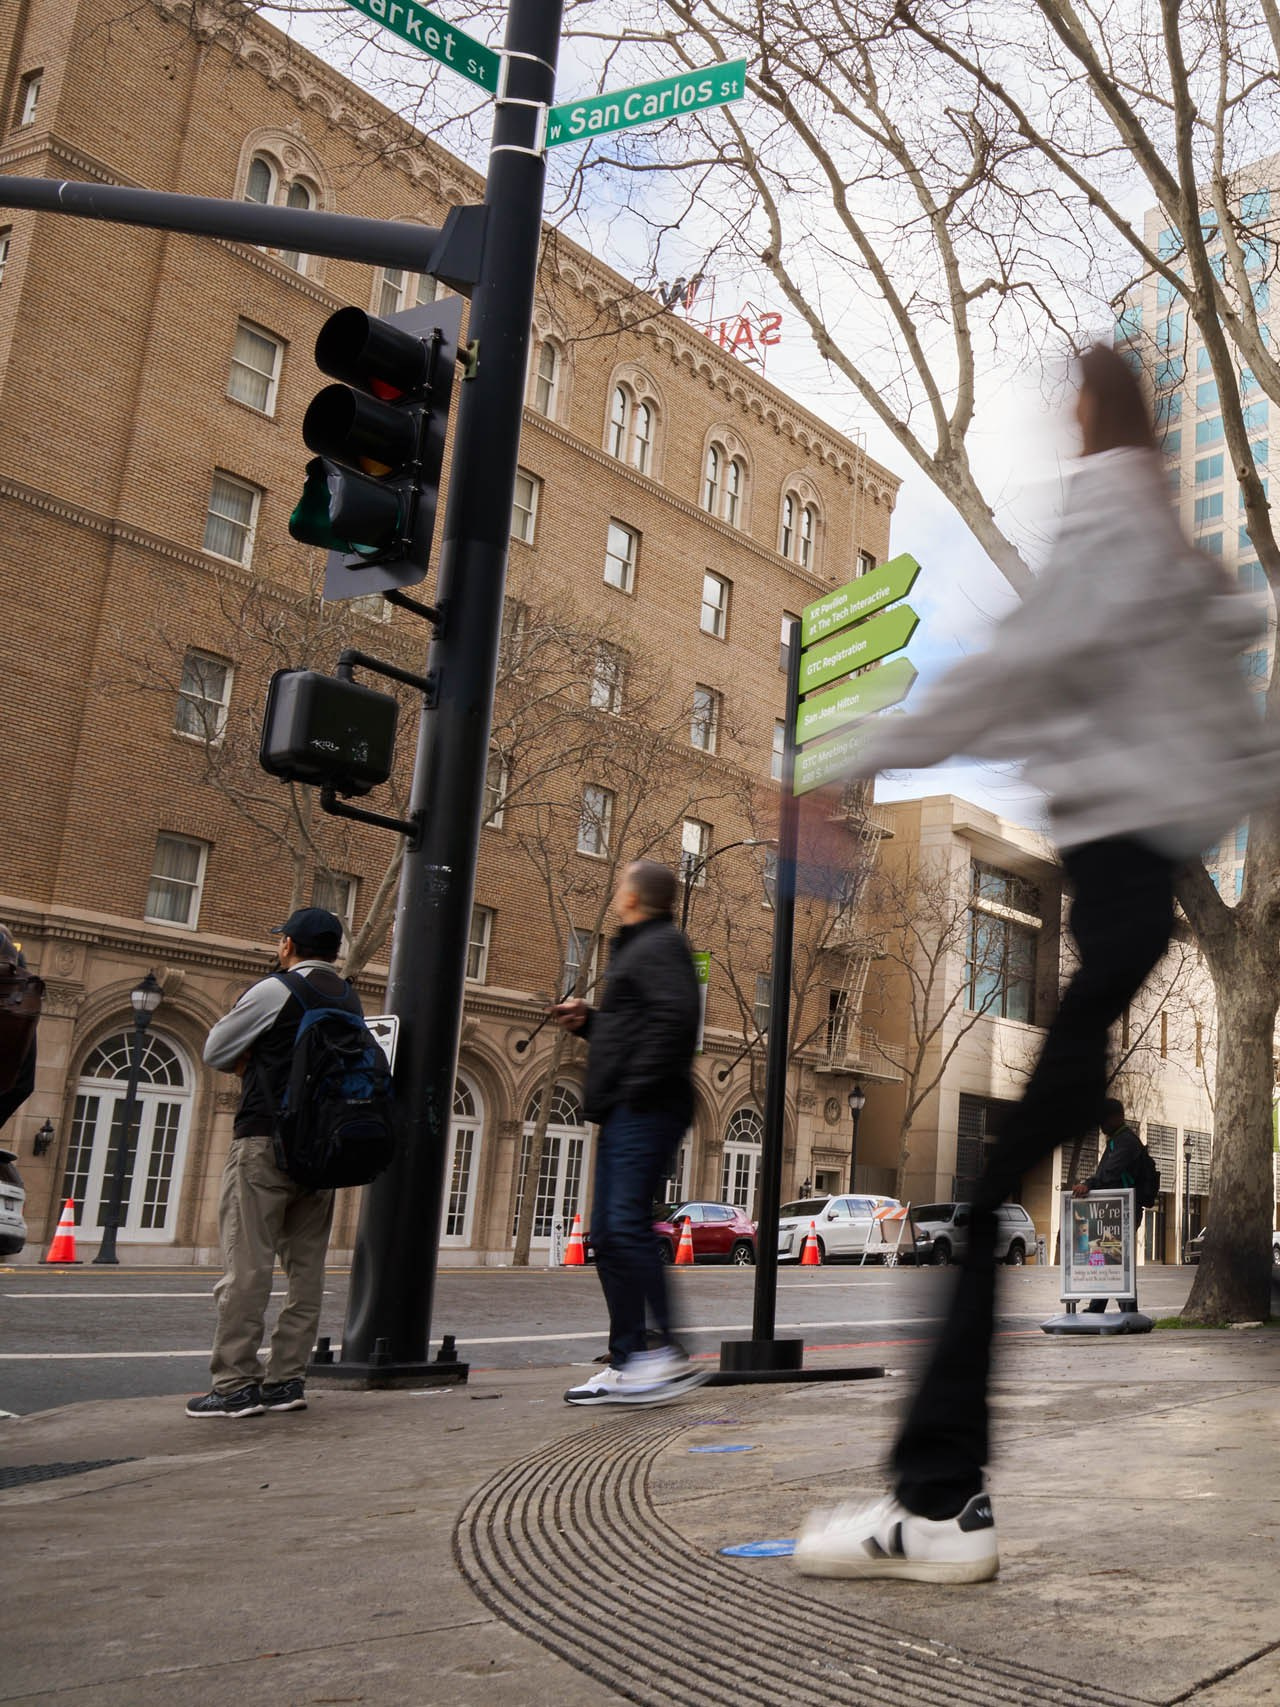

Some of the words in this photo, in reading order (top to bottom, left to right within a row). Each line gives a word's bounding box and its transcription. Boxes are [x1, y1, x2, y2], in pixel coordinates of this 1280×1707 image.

[467, 59, 486, 80] St
[550, 124, 562, 140] W
[568, 104, 620, 134] San
[624, 80, 713, 120] Carlos
[720, 80, 738, 97] St
[807, 660, 822, 676] GTC
[822, 640, 867, 668] Registration
[804, 713, 818, 726] San
[837, 694, 860, 711] Hilton
[1089, 1202, 1121, 1219] We're
